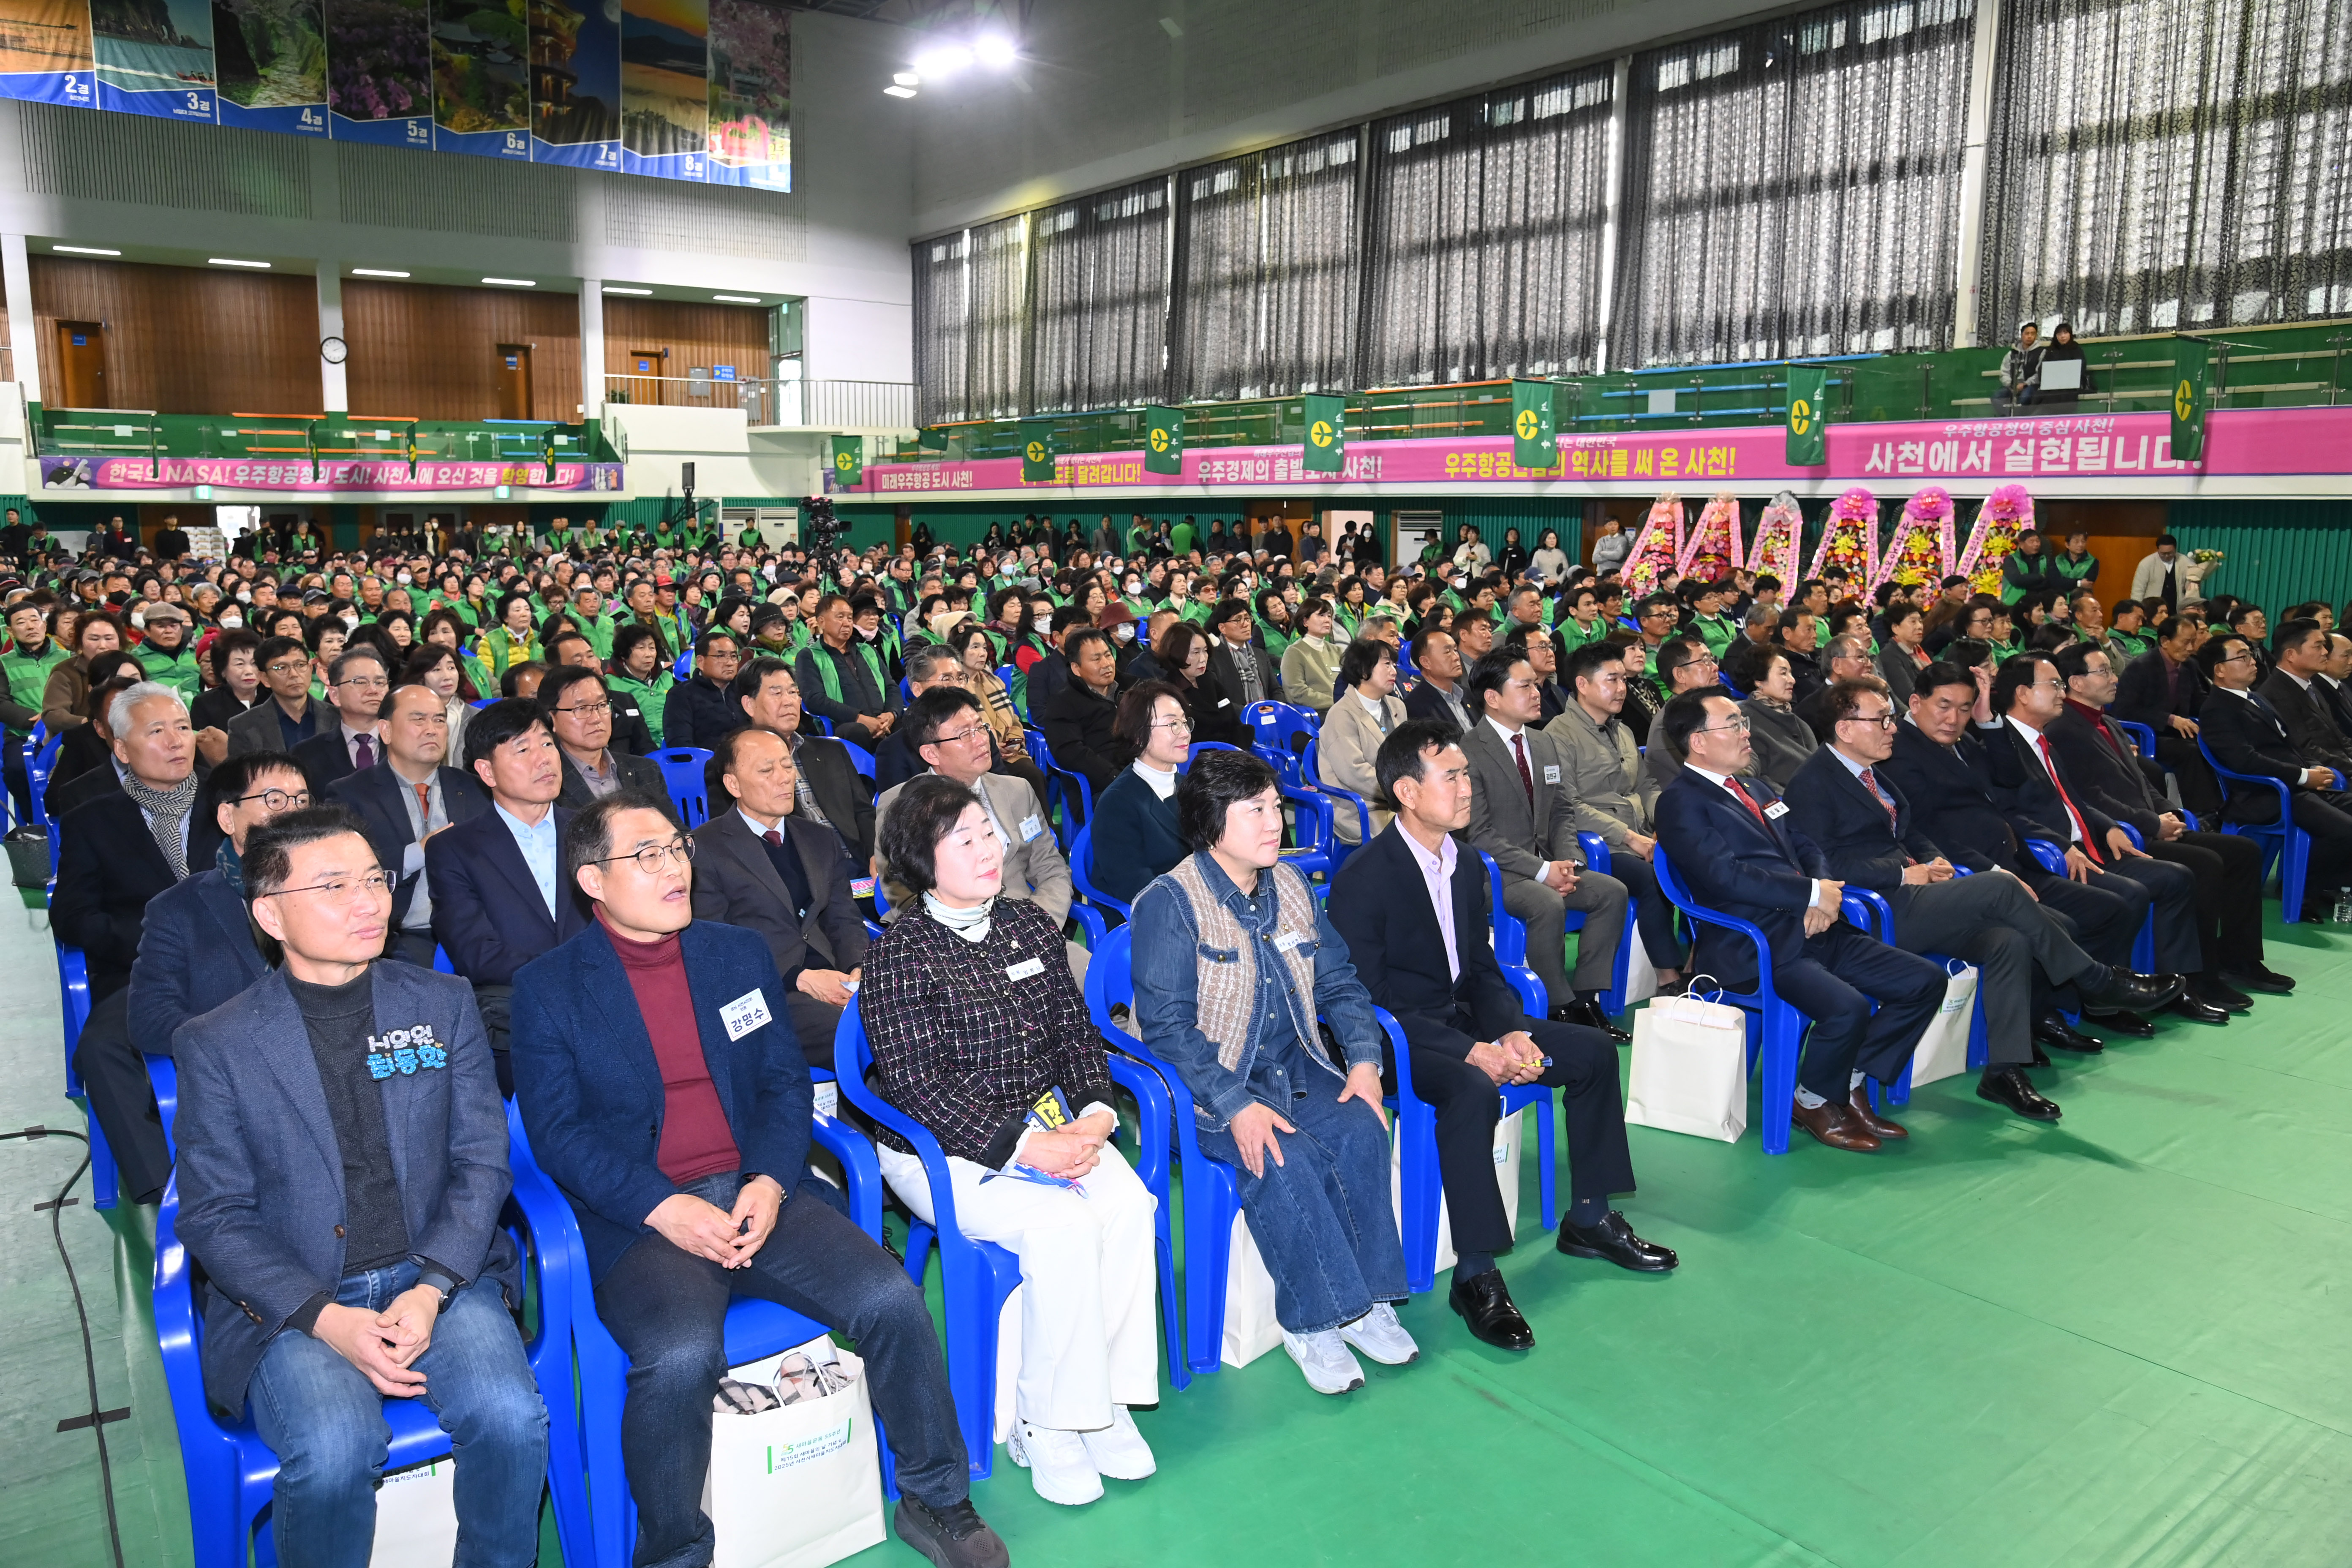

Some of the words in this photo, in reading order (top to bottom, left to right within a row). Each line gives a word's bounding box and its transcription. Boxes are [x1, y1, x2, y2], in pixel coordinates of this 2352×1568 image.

[1943, 422, 2035, 438] 우주항공청의
[2038, 420, 2071, 435] 중심
[2073, 418, 2115, 434] 사천!
[1575, 436, 1617, 448] 대한민국
[1571, 449, 1628, 477] 역사를
[1634, 449, 1653, 477] 써
[1660, 447, 1680, 476] 온
[1685, 446, 1737, 476] 사천!
[1865, 438, 1992, 474] 사천에서
[109, 463, 161, 483] 한국의
[165, 465, 231, 484] NASA!
[234, 466, 331, 485] 우주항공청의
[333, 466, 371, 485] 도시!
[373, 467, 435, 485] 사천시에
[436, 467, 466, 485] 오신
[469, 467, 498, 485] 것을
[882, 472, 930, 490] 미래우주항공
[932, 471, 950, 488] 도시
[951, 471, 973, 488] 사천!
[1078, 463, 1141, 484] 달려갑니다!
[1198, 460, 1269, 483] 우주경제의
[1342, 456, 1382, 479] 사천!
[731, 1008, 764, 1032] 강명수
[368, 1025, 435, 1052] 시의원
[796, 1436, 823, 1448] 새마을운동
[824, 1429, 841, 1439] 55주년
[774, 1462, 794, 1471] 2025년
[795, 1439, 847, 1464] 사천시새마을지도자대회
[781, 1454, 798, 1462] 제15회
[800, 1446, 819, 1456] 새마을의
